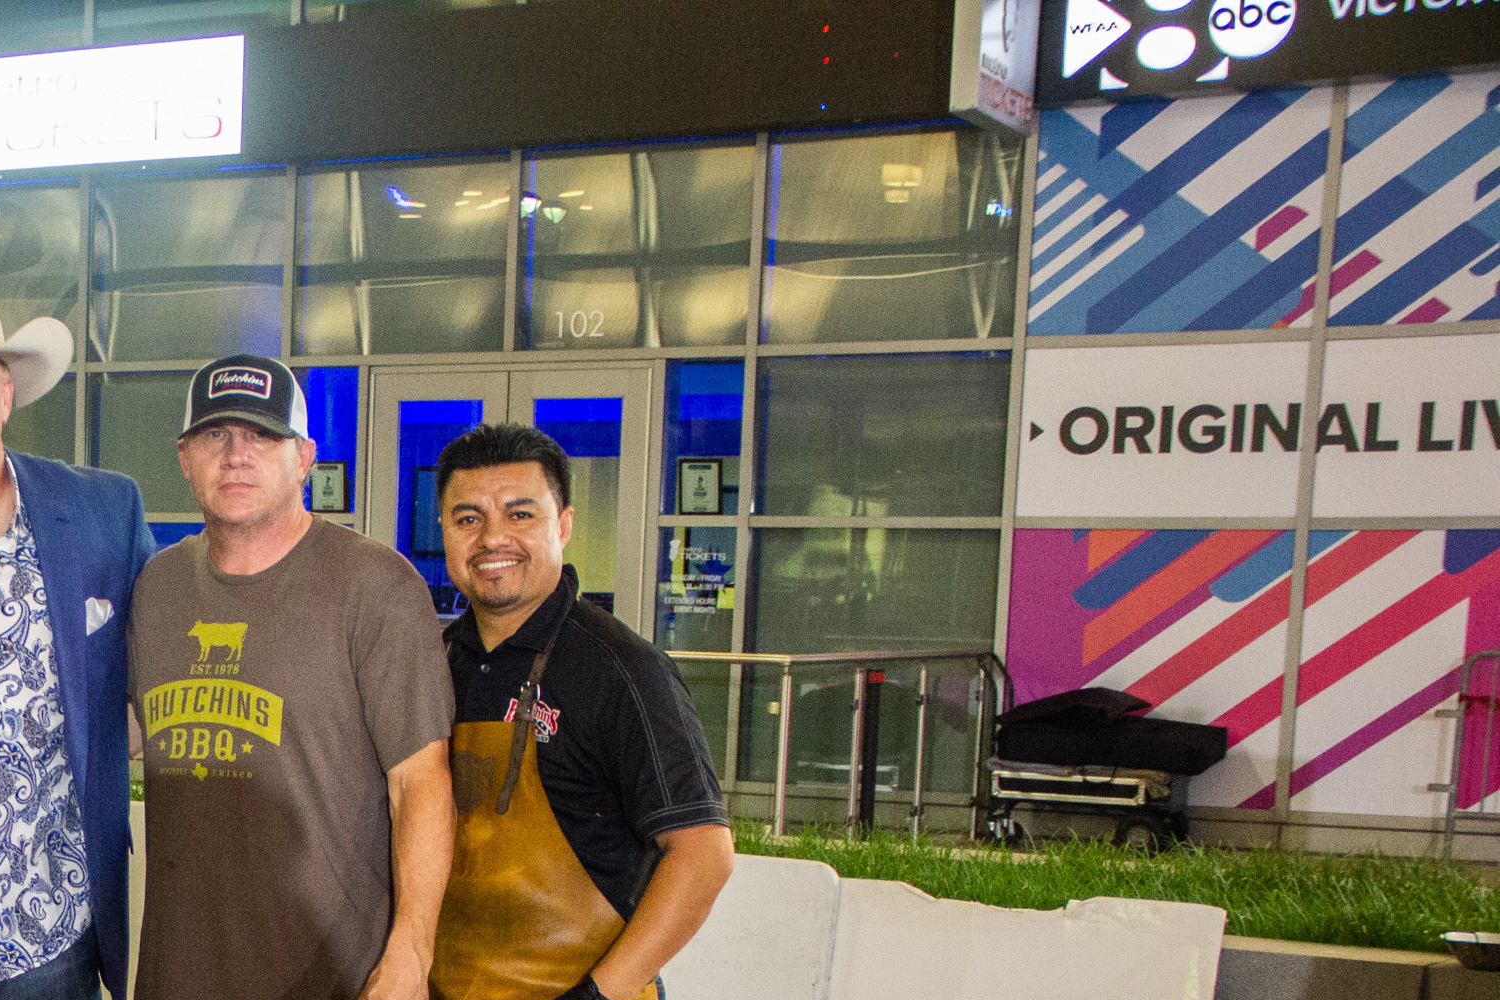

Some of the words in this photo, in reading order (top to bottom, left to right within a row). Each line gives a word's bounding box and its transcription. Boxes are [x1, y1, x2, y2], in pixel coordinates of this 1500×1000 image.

[1070, 21, 1119, 35] WFAA
[1211, 0, 1292, 31] abc
[556, 310, 604, 338] 102
[1058, 403, 1400, 456] ORIGINAL
[190, 664, 213, 675] EST.
[215, 664, 240, 675] 1978
[150, 686, 270, 727] HUTCHINS
[169, 728, 237, 762] BBQ
